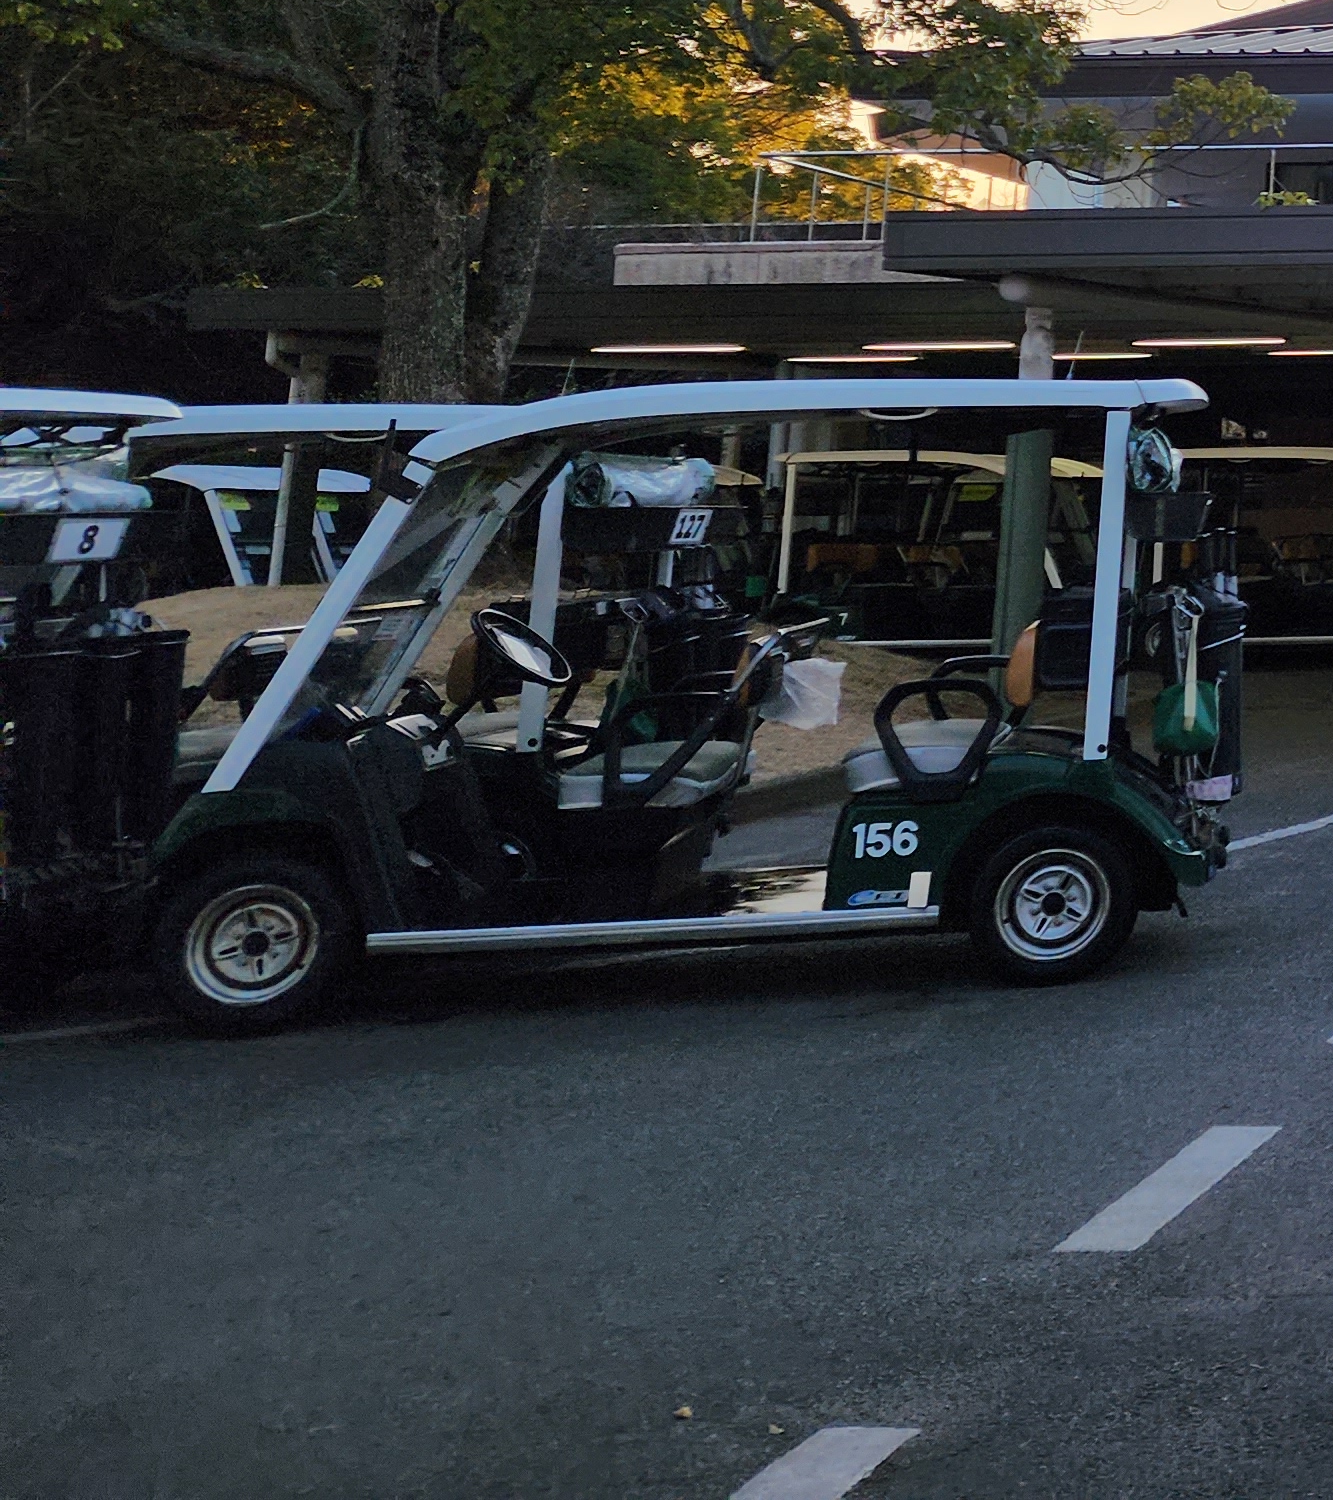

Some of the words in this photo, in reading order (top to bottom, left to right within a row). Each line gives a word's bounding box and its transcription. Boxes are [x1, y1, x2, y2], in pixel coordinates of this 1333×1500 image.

[78, 525, 99, 554] 8
[676, 515, 705, 538] 127
[852, 820, 920, 859] 156
